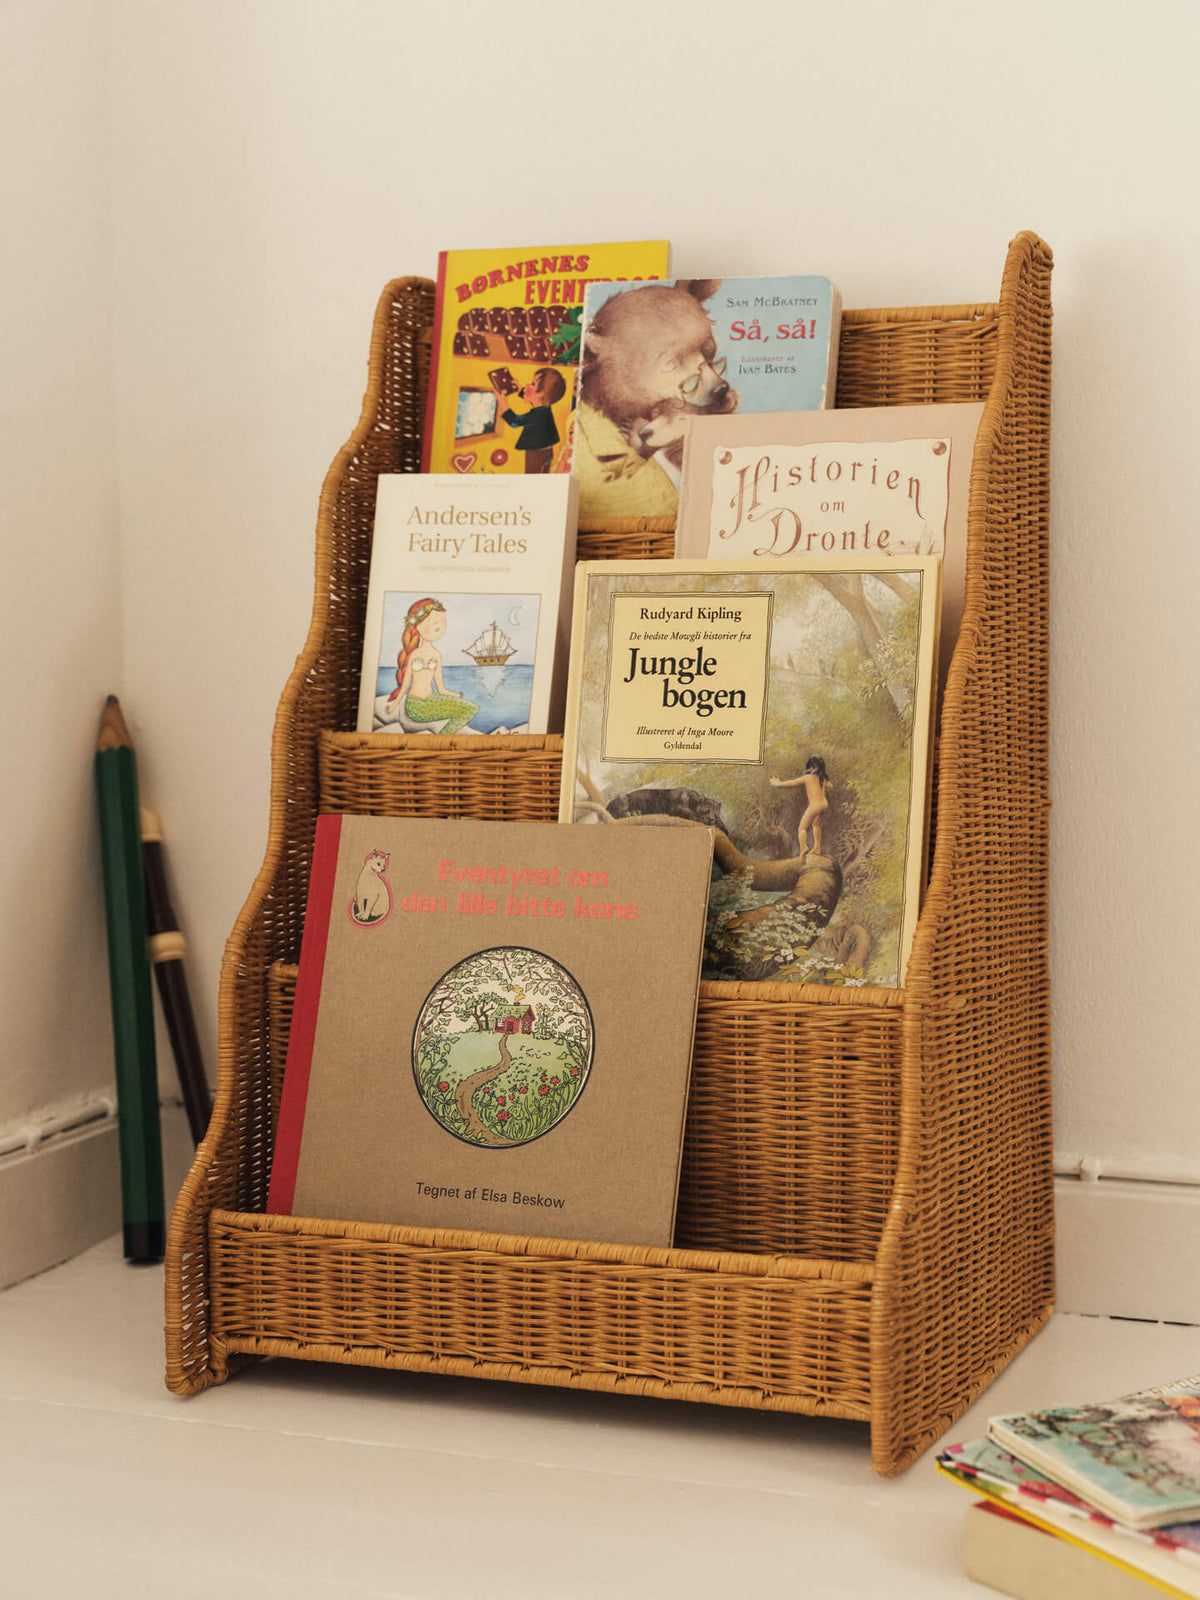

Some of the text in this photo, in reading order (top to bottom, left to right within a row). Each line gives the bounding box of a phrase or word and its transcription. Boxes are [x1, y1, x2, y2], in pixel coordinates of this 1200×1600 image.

[455, 255, 590, 303] BØRNENES
[525, 275, 659, 304] EVENT
[729, 317, 817, 343] Så, så!
[764, 363, 797, 374] BATES
[719, 454, 925, 540] Historien
[820, 499, 845, 514] om
[406, 505, 532, 526] Andersen's
[747, 507, 891, 556] Dronte
[408, 532, 527, 558] Fairy Tales
[640, 607, 742, 622] Rudyard Kipling
[629, 631, 751, 642] De bedste Mowgli historier fra
[623, 646, 717, 685] Jungle
[662, 678, 747, 718] bogen
[636, 726, 734, 738] Illustreret af Inga Moore
[663, 741, 702, 751] Gyldendal
[437, 860, 608, 889] Eventyret om
[401, 891, 638, 920] den lille bitte kone
[416, 1182, 565, 1209] Tegnet af Elsa Beskow
